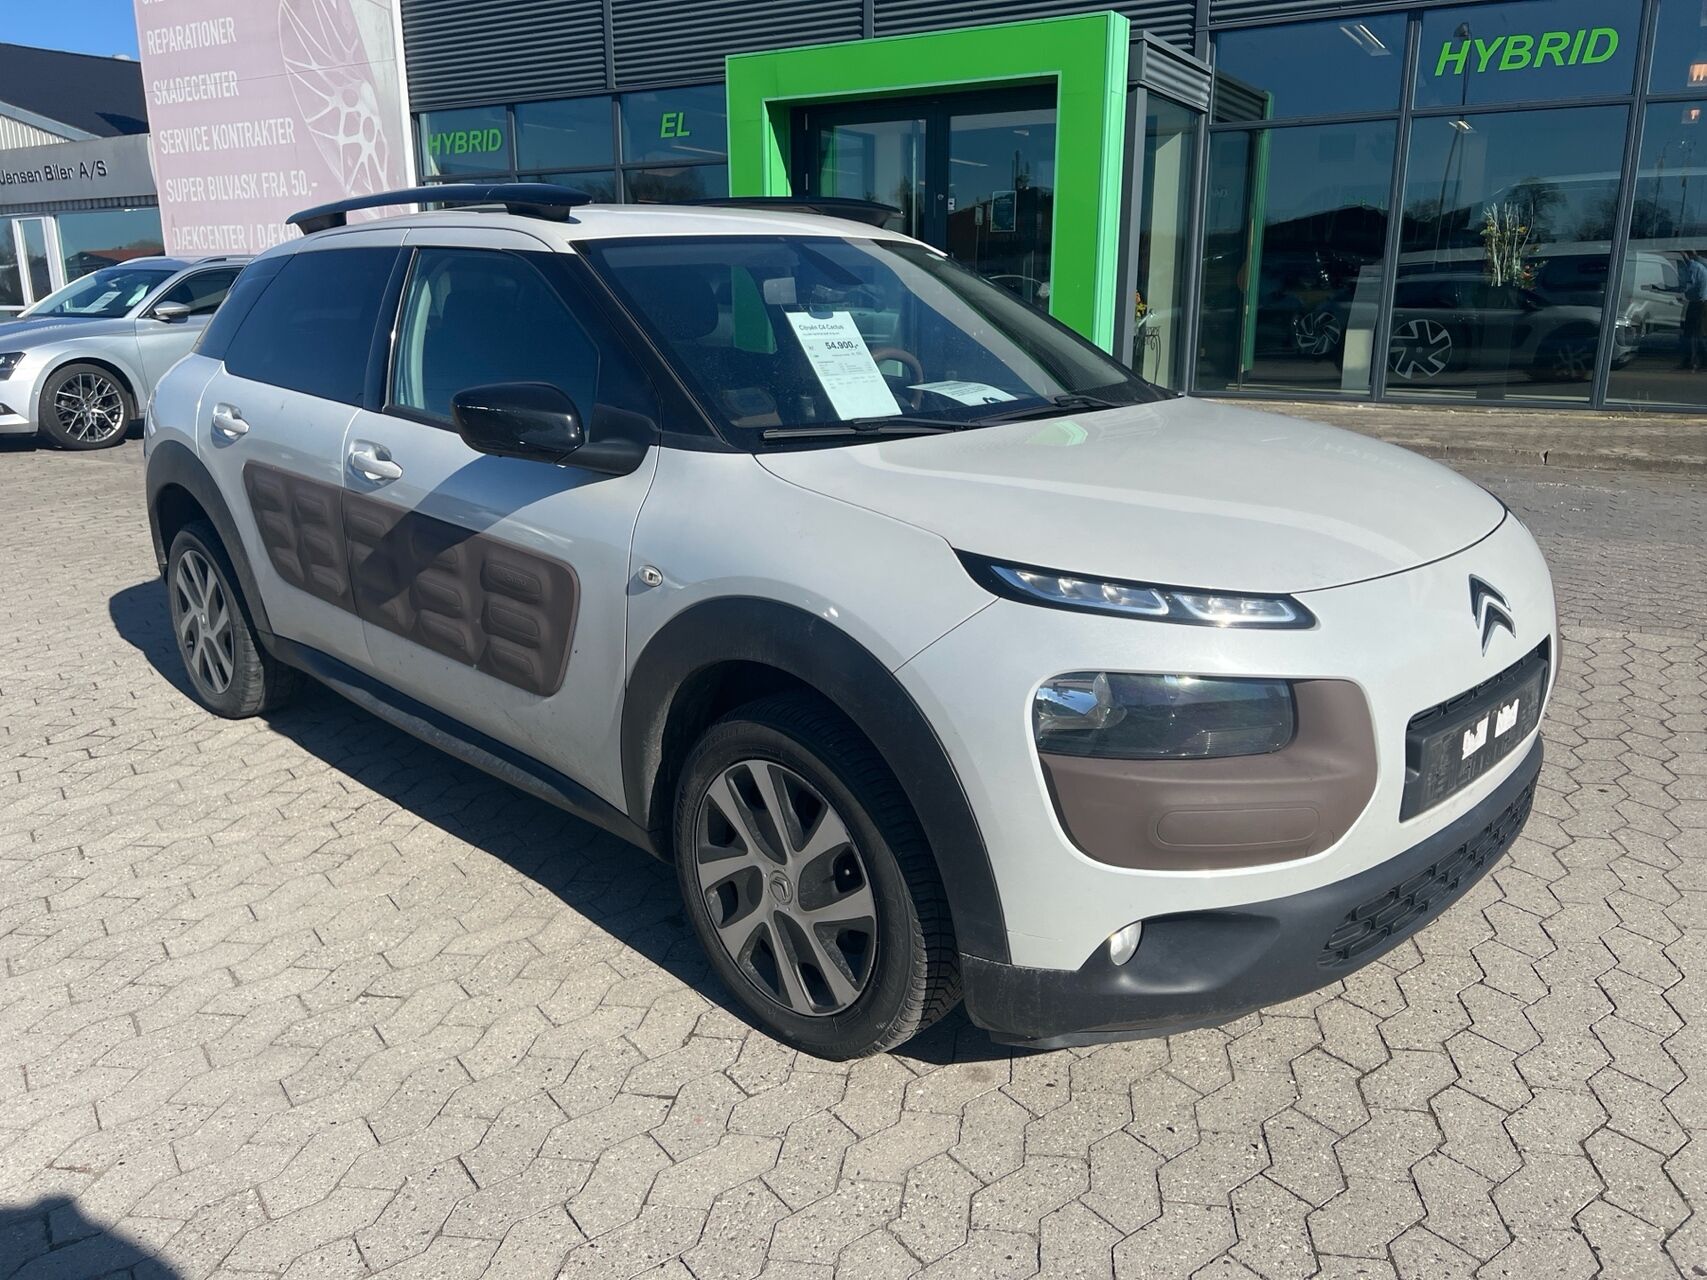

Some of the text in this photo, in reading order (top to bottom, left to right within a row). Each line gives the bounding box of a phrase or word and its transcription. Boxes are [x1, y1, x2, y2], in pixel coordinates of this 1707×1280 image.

[146, 17, 238, 56] REPARATIONER
[1435, 26, 1619, 77] HYBRID
[152, 70, 240, 105] SKADECENTER
[159, 117, 296, 155] SERVICE KONTRAKTER
[659, 111, 691, 140] EL
[428, 127, 502, 157] HYBRID
[0, 159, 108, 186] Jensen Biler A/S
[165, 177, 207, 203] SUPER
[209, 173, 260, 201] BILVASK
[263, 171, 288, 198] FRA
[173, 224, 247, 251] DÆKCENTER
